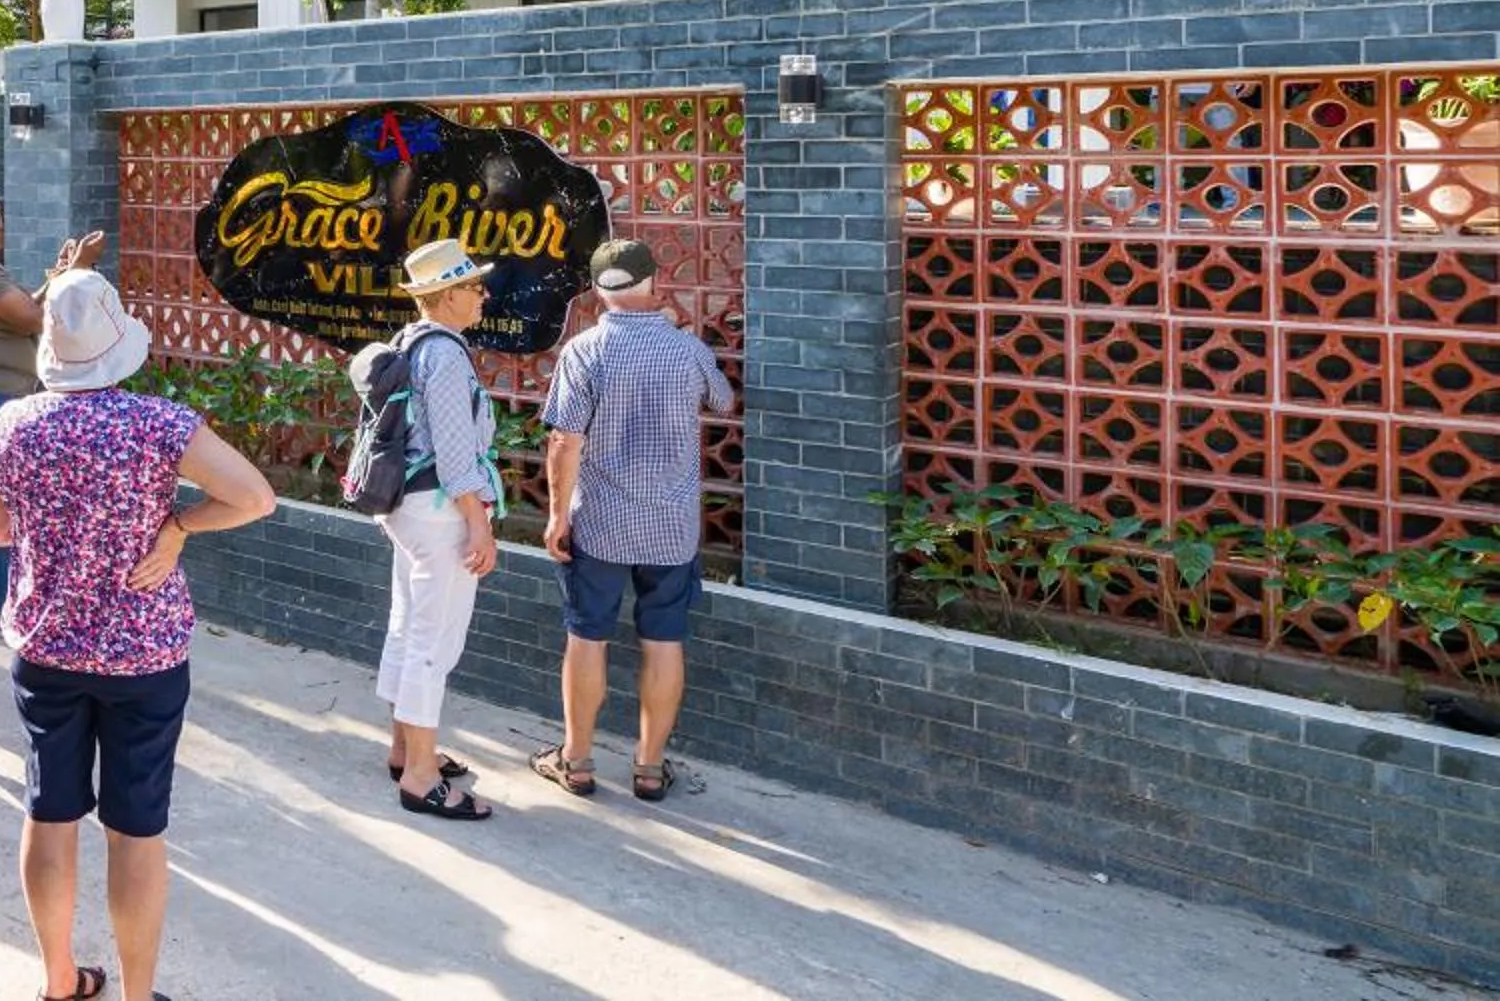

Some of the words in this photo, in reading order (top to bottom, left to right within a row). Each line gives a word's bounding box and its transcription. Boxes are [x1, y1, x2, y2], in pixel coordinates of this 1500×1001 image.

[218, 171, 383, 267] Grace
[407, 182, 566, 259] River
[306, 262, 413, 297] VILL
